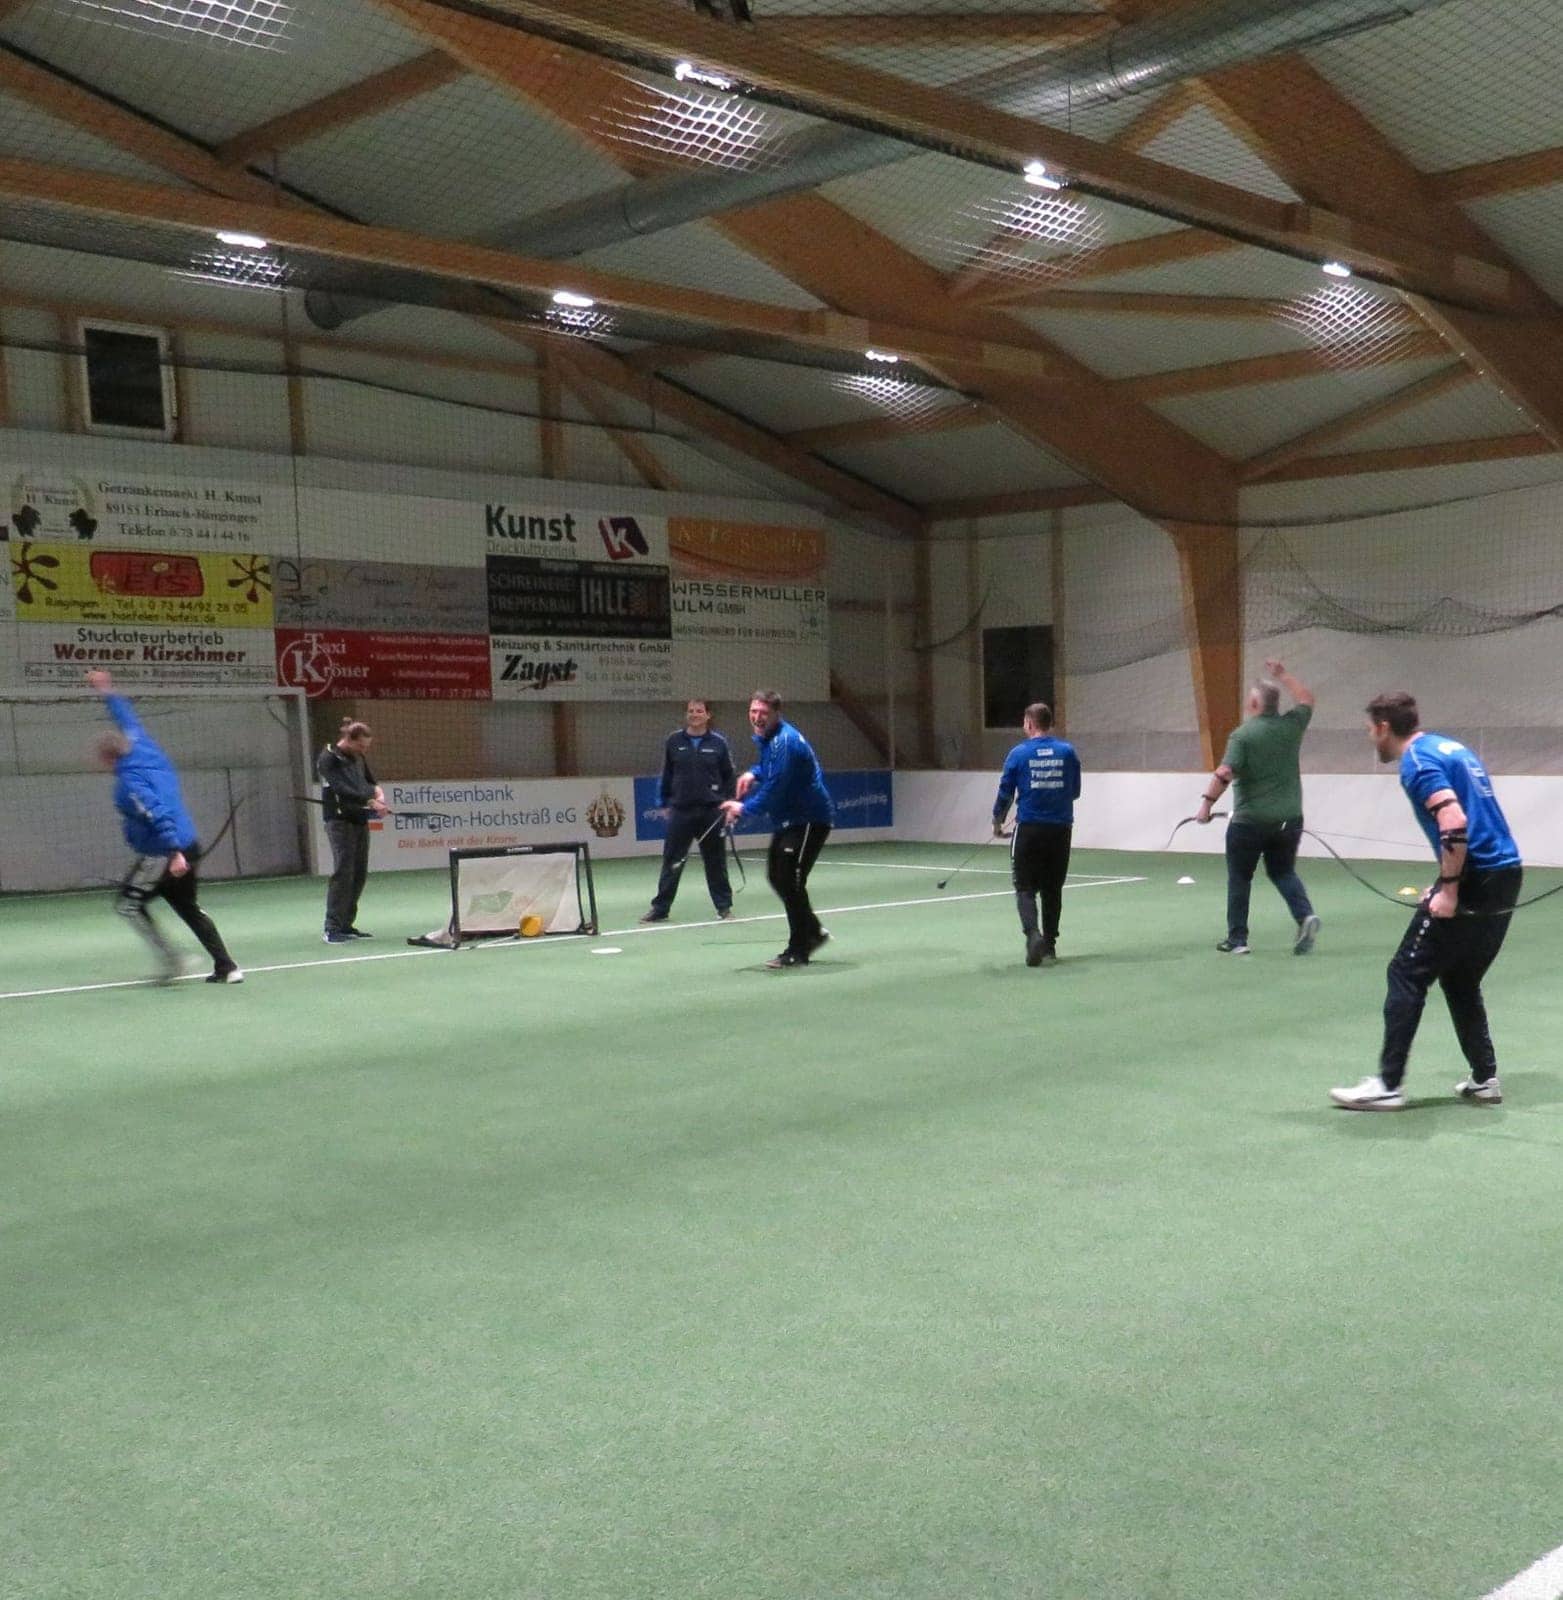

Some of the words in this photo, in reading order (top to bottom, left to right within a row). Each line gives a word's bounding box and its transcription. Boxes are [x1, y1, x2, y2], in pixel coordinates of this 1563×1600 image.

[486, 504, 577, 543] Kunst
[581, 577, 628, 616] IHLE
[673, 600, 713, 613] ULM
[77, 628, 224, 645] Stuckateurbetrieb
[54, 644, 134, 661] Werner
[143, 645, 246, 663] Kirschmer
[492, 639, 541, 653] Heizung
[500, 655, 578, 691] Zagst
[393, 784, 514, 804] Raiffeisenbank
[555, 807, 577, 823] eG
[398, 839, 415, 848] Die
